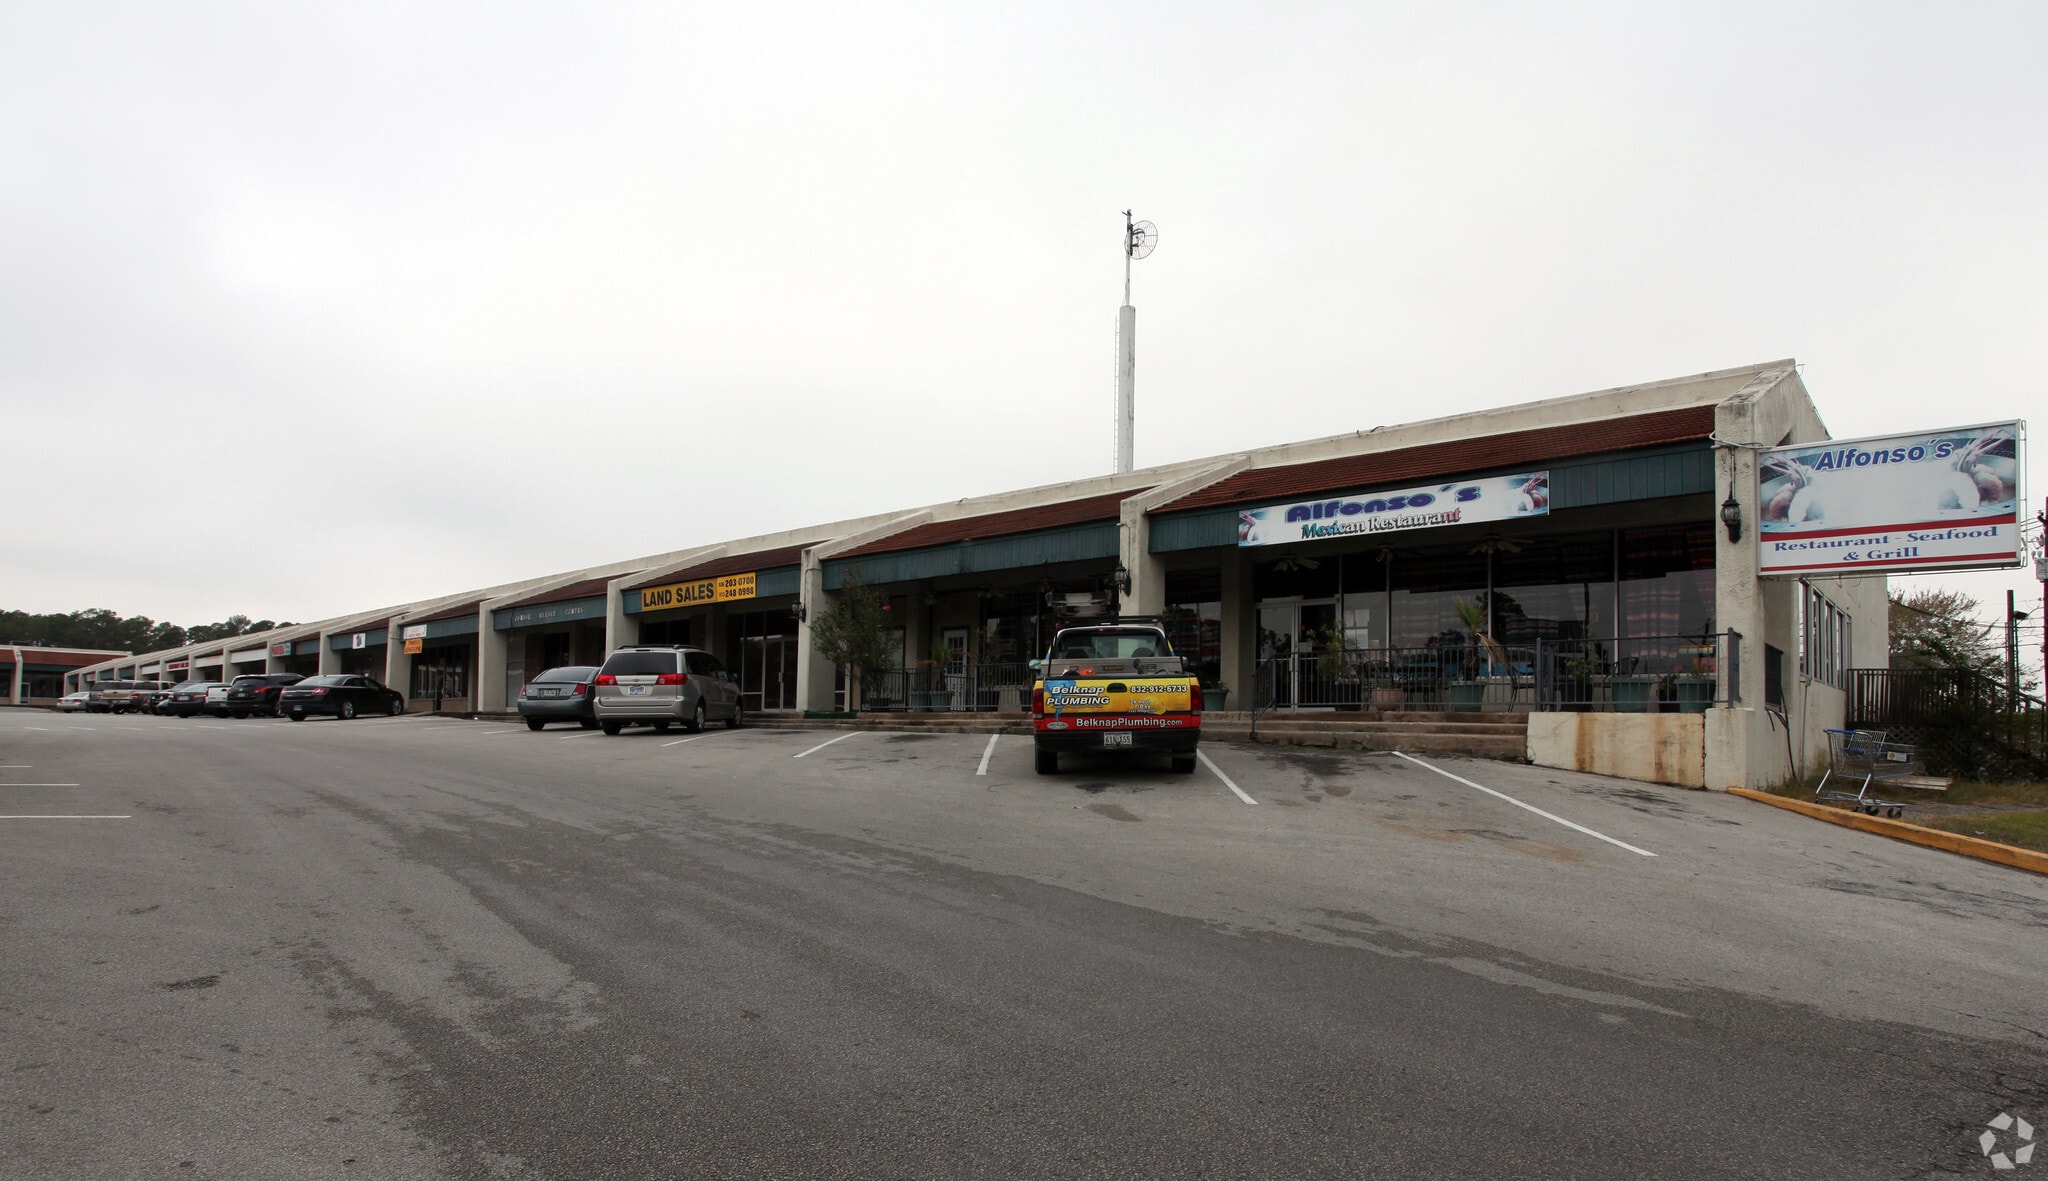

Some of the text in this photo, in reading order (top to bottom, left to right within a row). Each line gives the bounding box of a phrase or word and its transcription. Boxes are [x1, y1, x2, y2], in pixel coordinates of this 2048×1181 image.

[1814, 438, 1954, 472] Alfonso's
[1285, 484, 1481, 524] Alfonso's
[1301, 507, 1462, 539] Mexican Restaurant
[1775, 535, 1890, 552] Restaurant
[1907, 525, 1999, 543] Seafood
[1843, 546, 1919, 561] & Grill
[725, 578, 737, 588] 203
[643, 582, 715, 607] LAND SALES
[725, 588, 737, 598] 248
[1051, 685, 1187, 696] Belknap 832-912-6733
[1046, 696, 1110, 705] PLUMBING
[1076, 717, 1183, 728] BelknapPlumbing.com
